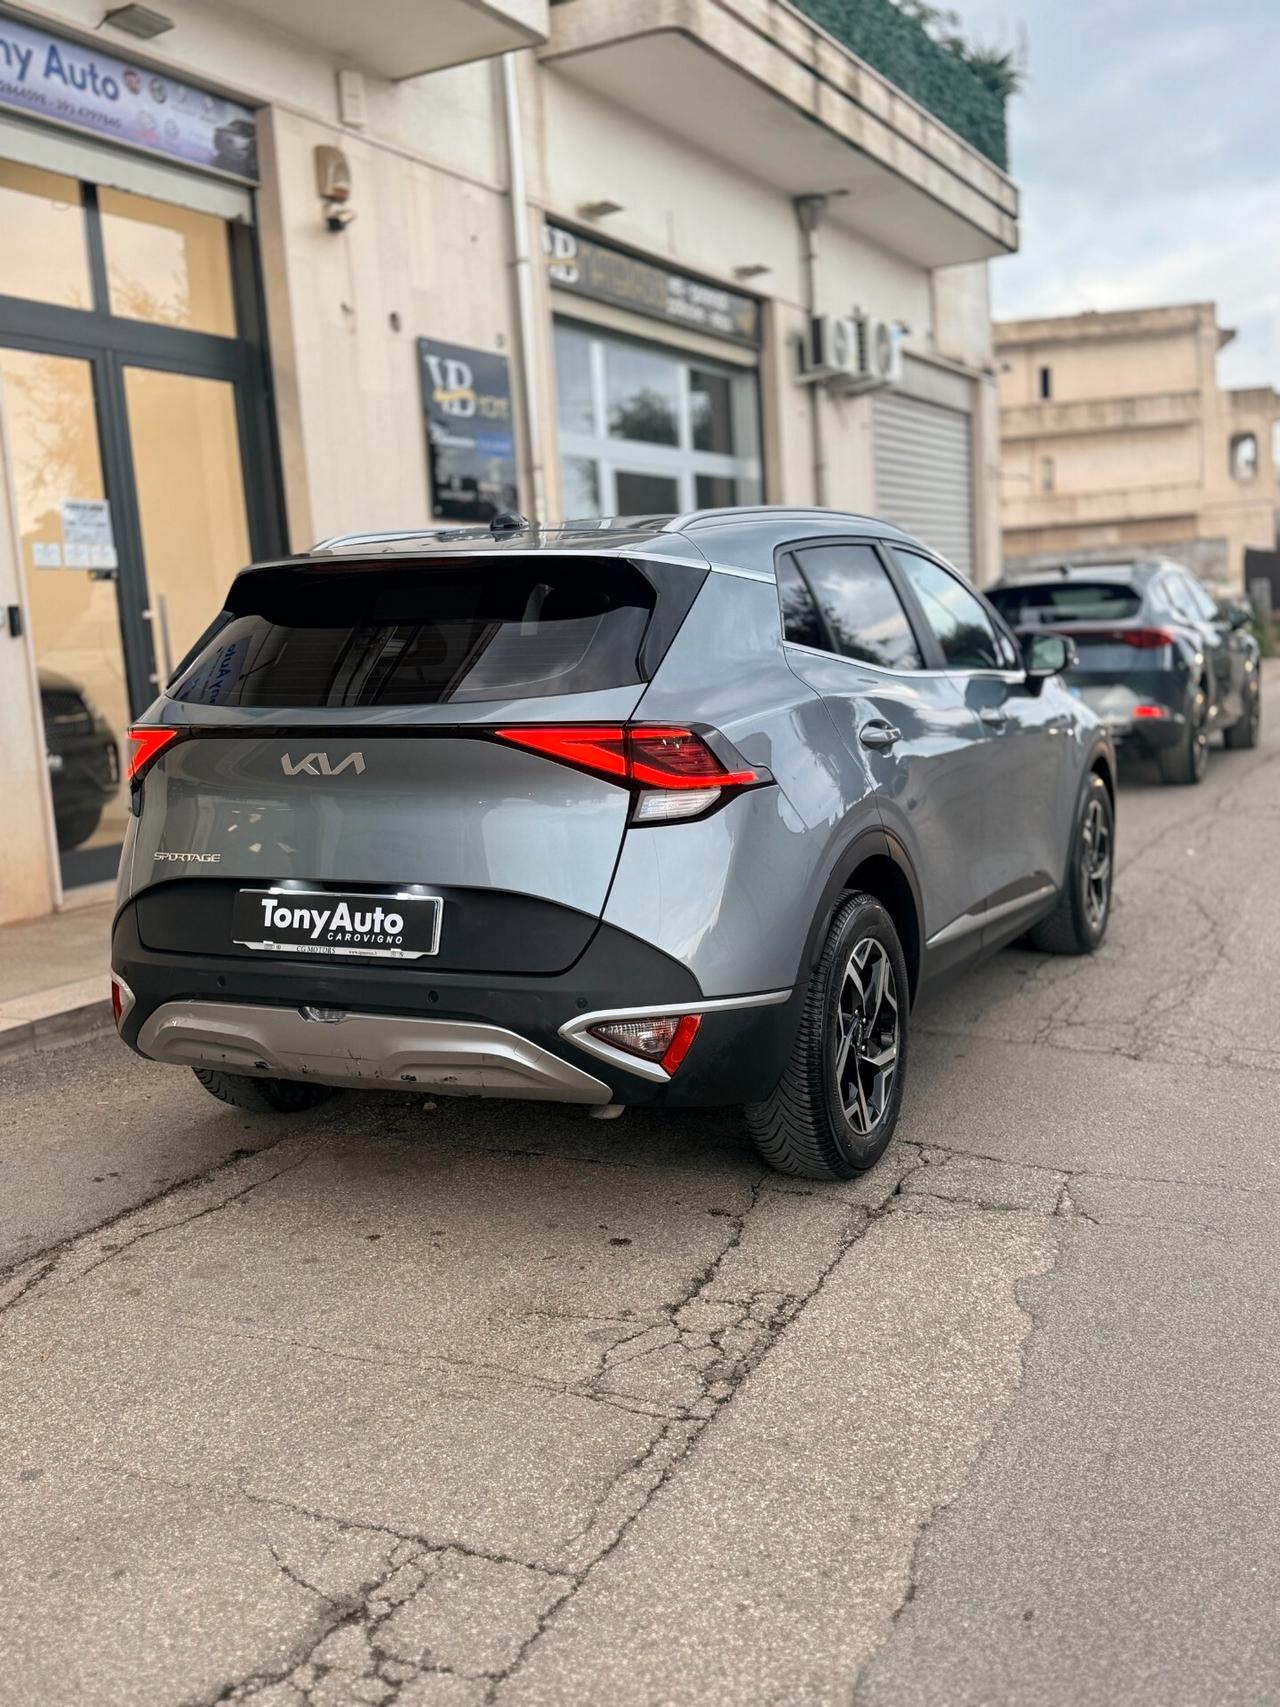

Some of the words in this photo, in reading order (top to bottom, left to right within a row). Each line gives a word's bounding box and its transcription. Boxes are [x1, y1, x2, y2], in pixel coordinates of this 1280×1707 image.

[43, 43, 120, 101] Auto
[280, 752, 366, 775] KIA
[153, 851, 221, 863] SPORTAGE
[261, 898, 404, 939] TonyAuto
[327, 932, 403, 944] CAROVIGNO
